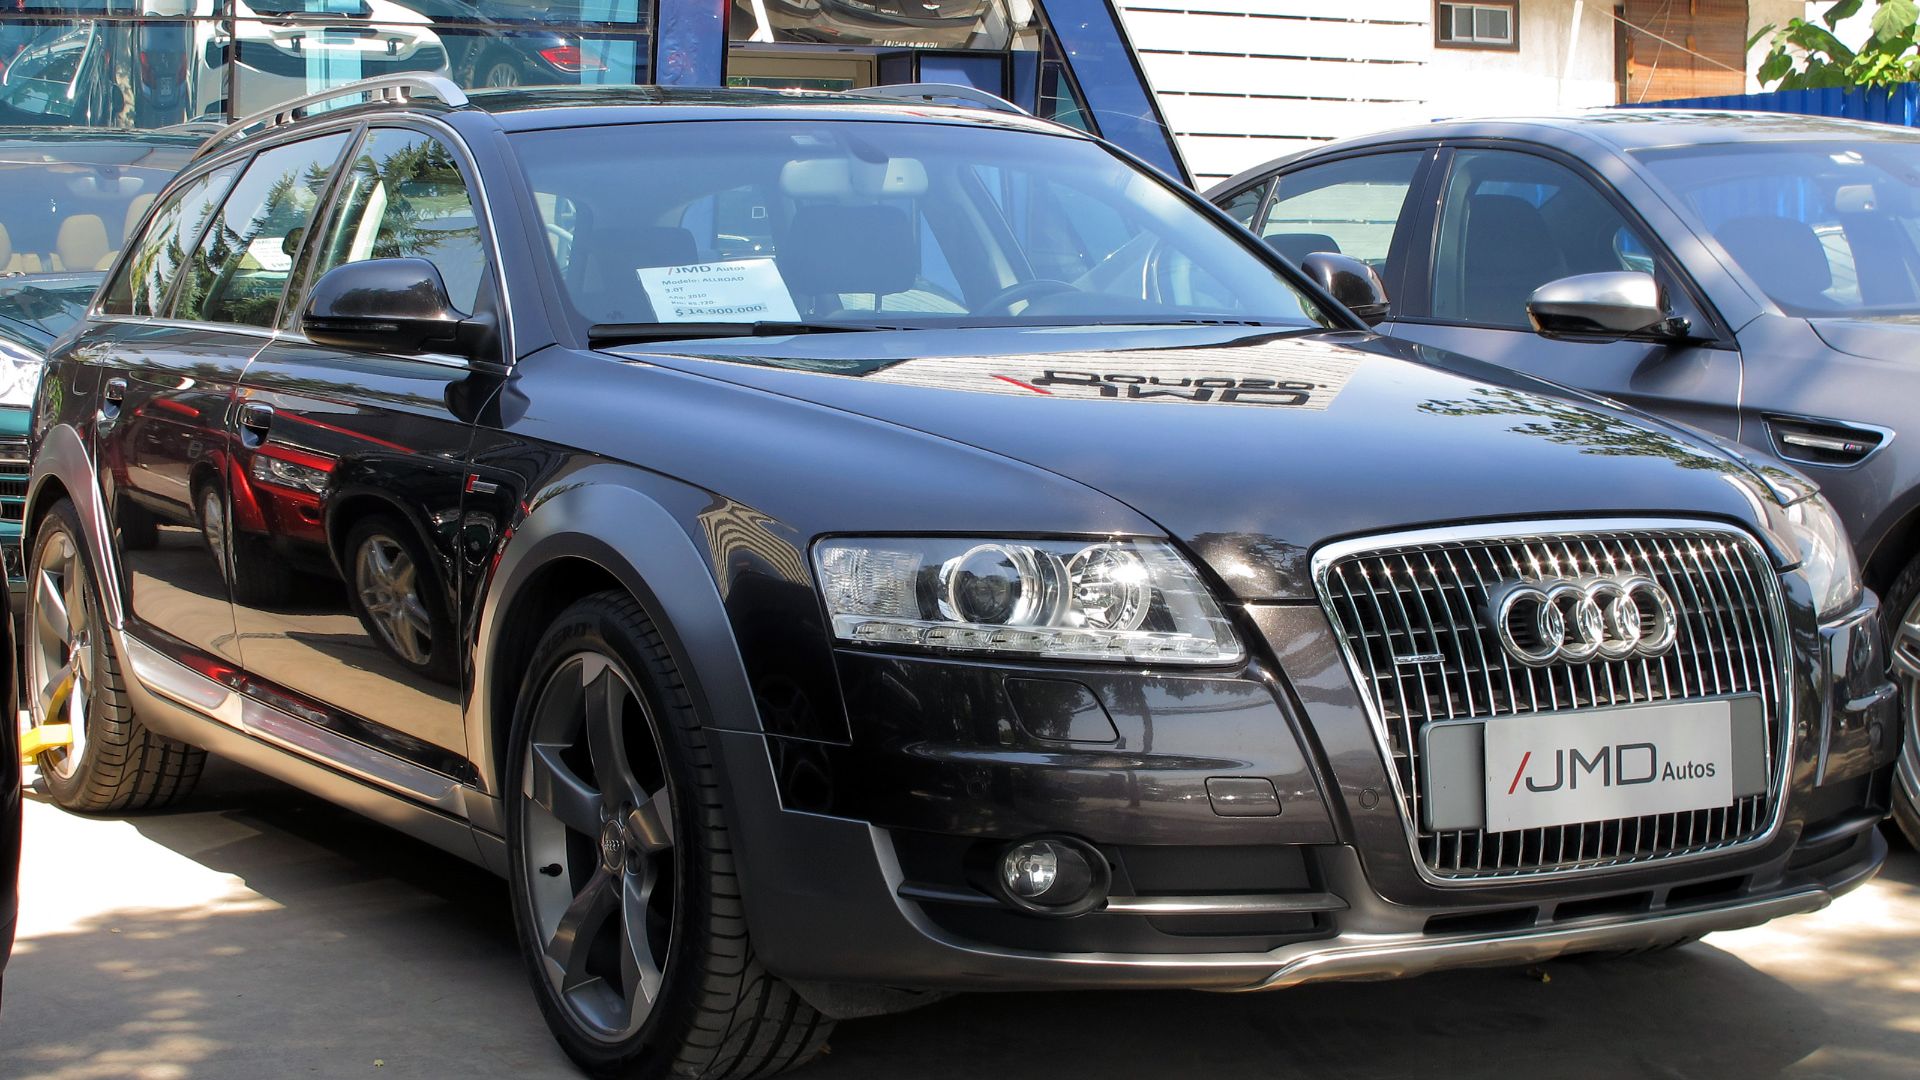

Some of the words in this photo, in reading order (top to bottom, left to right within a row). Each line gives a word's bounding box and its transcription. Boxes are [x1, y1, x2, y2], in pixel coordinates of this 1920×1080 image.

[662, 278, 700, 286] Modelo:
[675, 308, 684, 317] $
[1662, 760, 1716, 782] Autos
